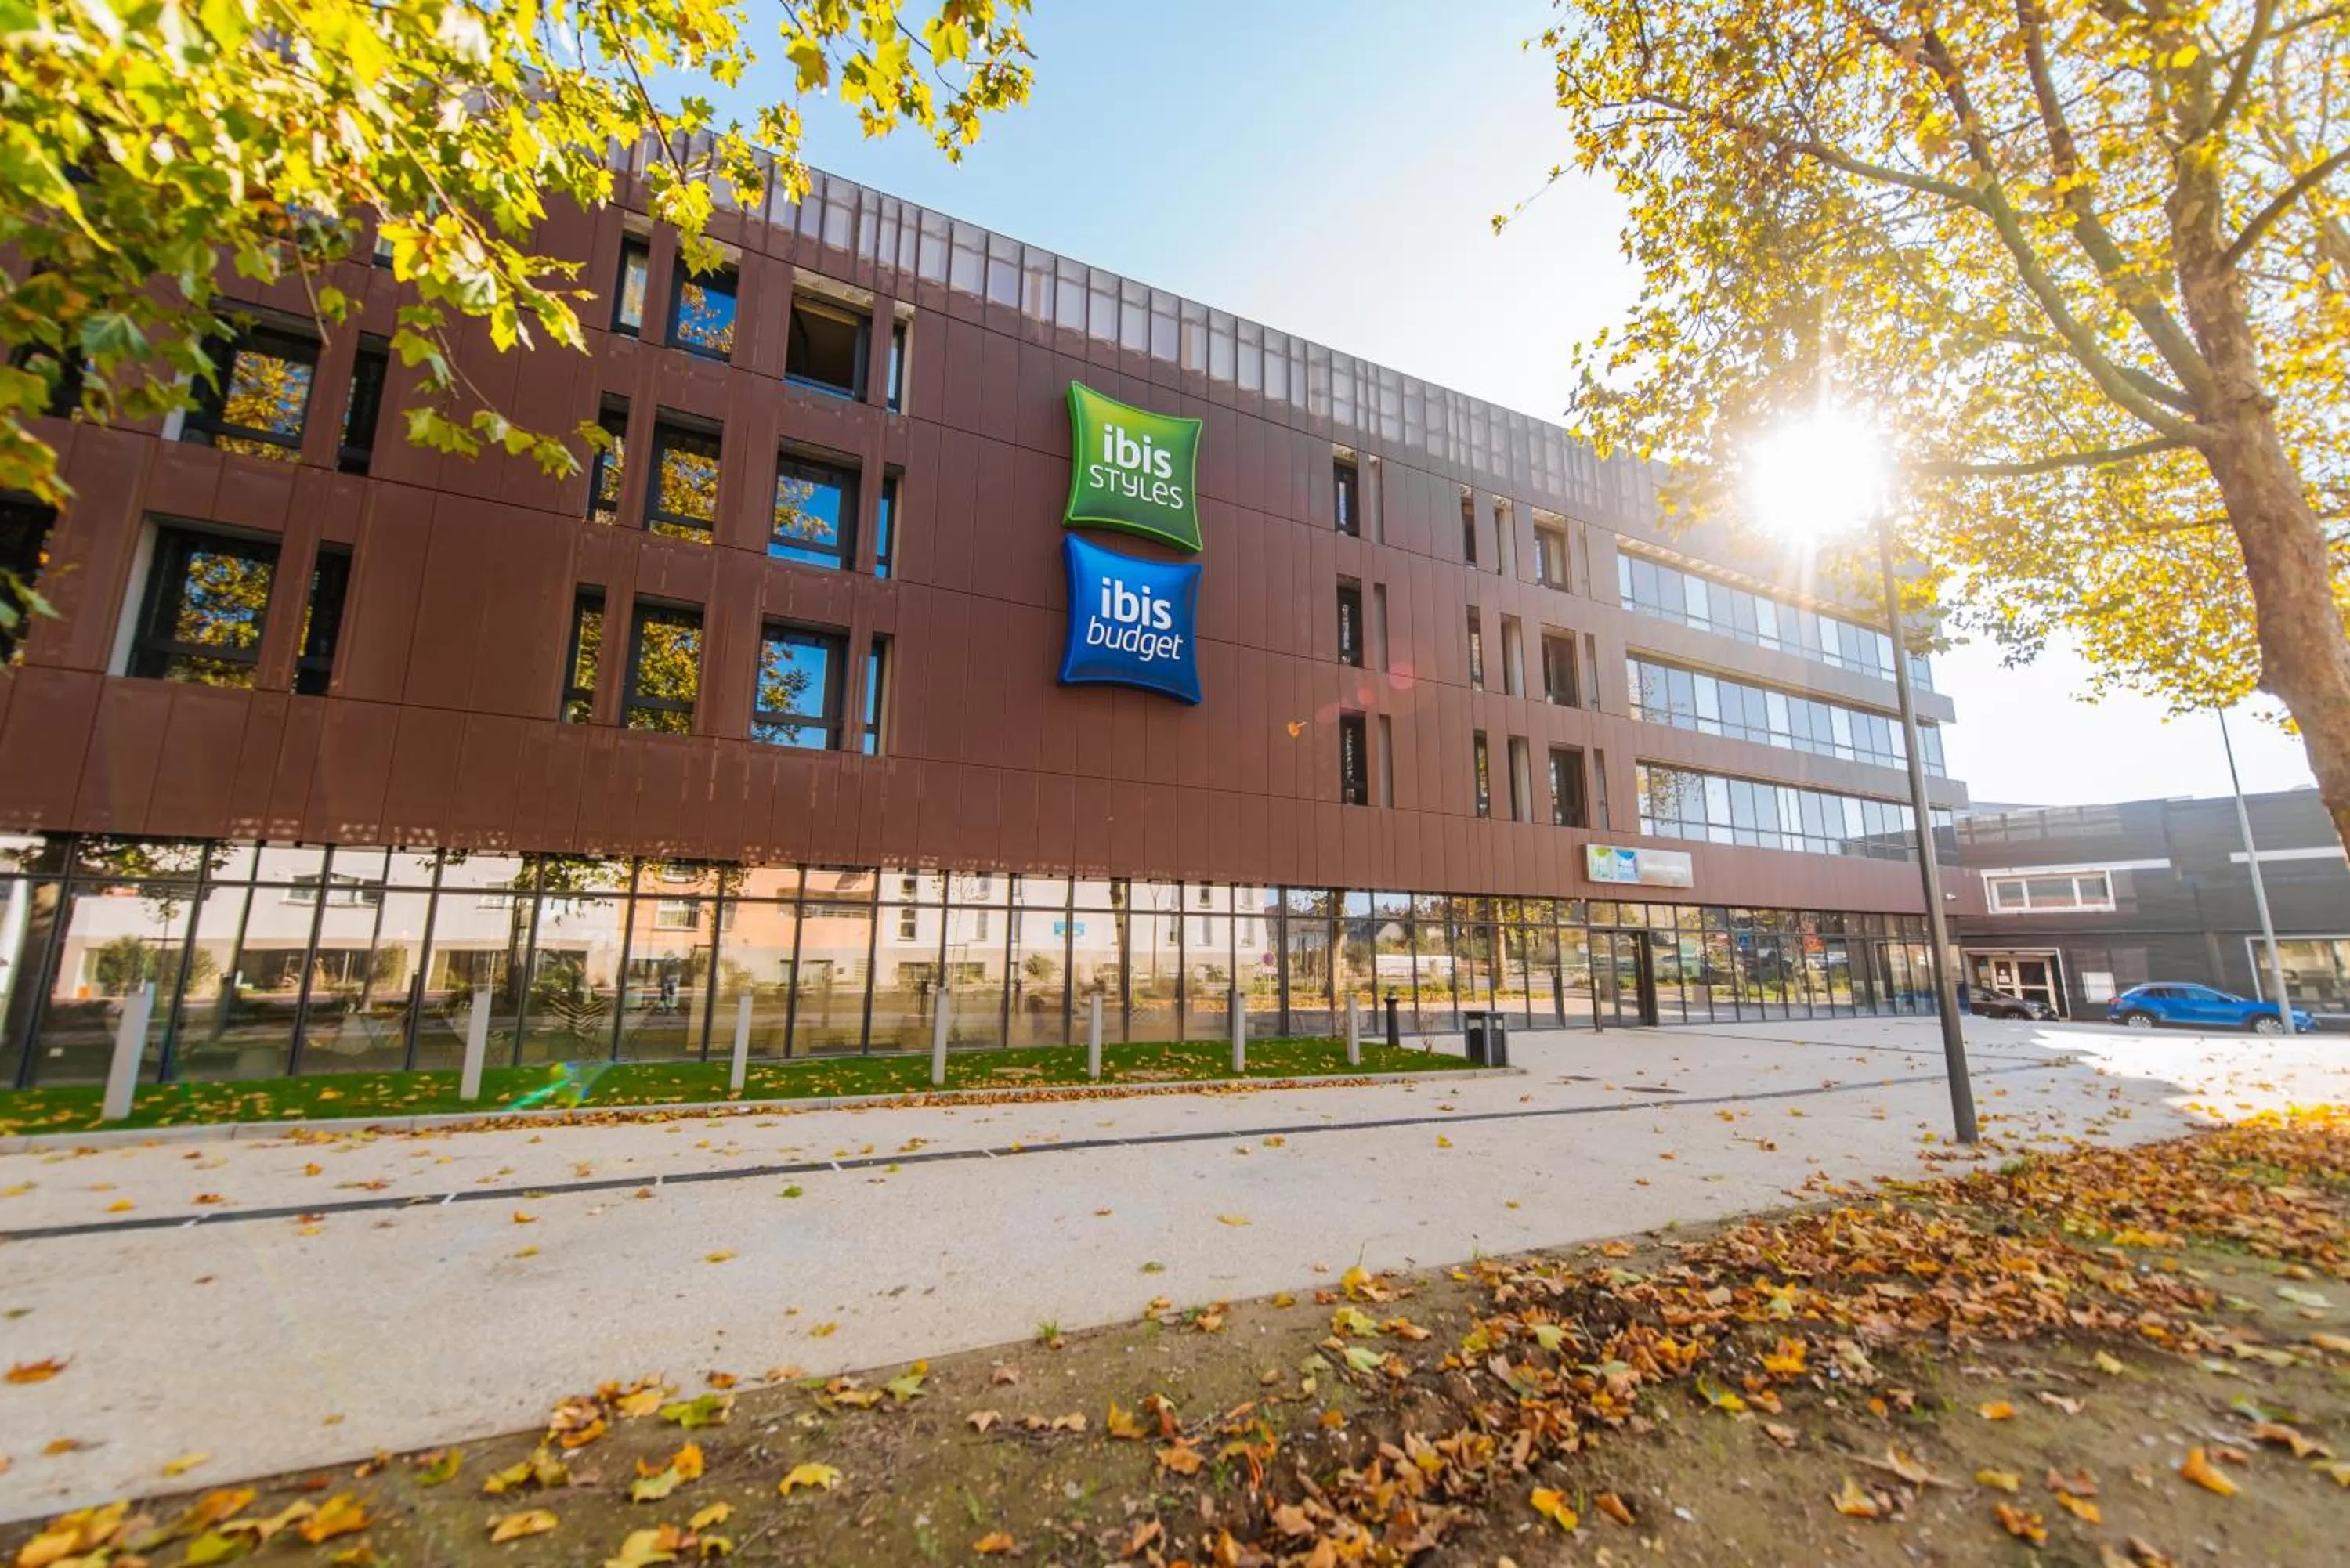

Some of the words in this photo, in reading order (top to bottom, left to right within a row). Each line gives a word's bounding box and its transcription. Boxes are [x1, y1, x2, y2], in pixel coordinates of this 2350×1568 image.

[1104, 423, 1173, 479] ibis
[1101, 577, 1172, 630] ibis
[1086, 616, 1184, 662] budget
